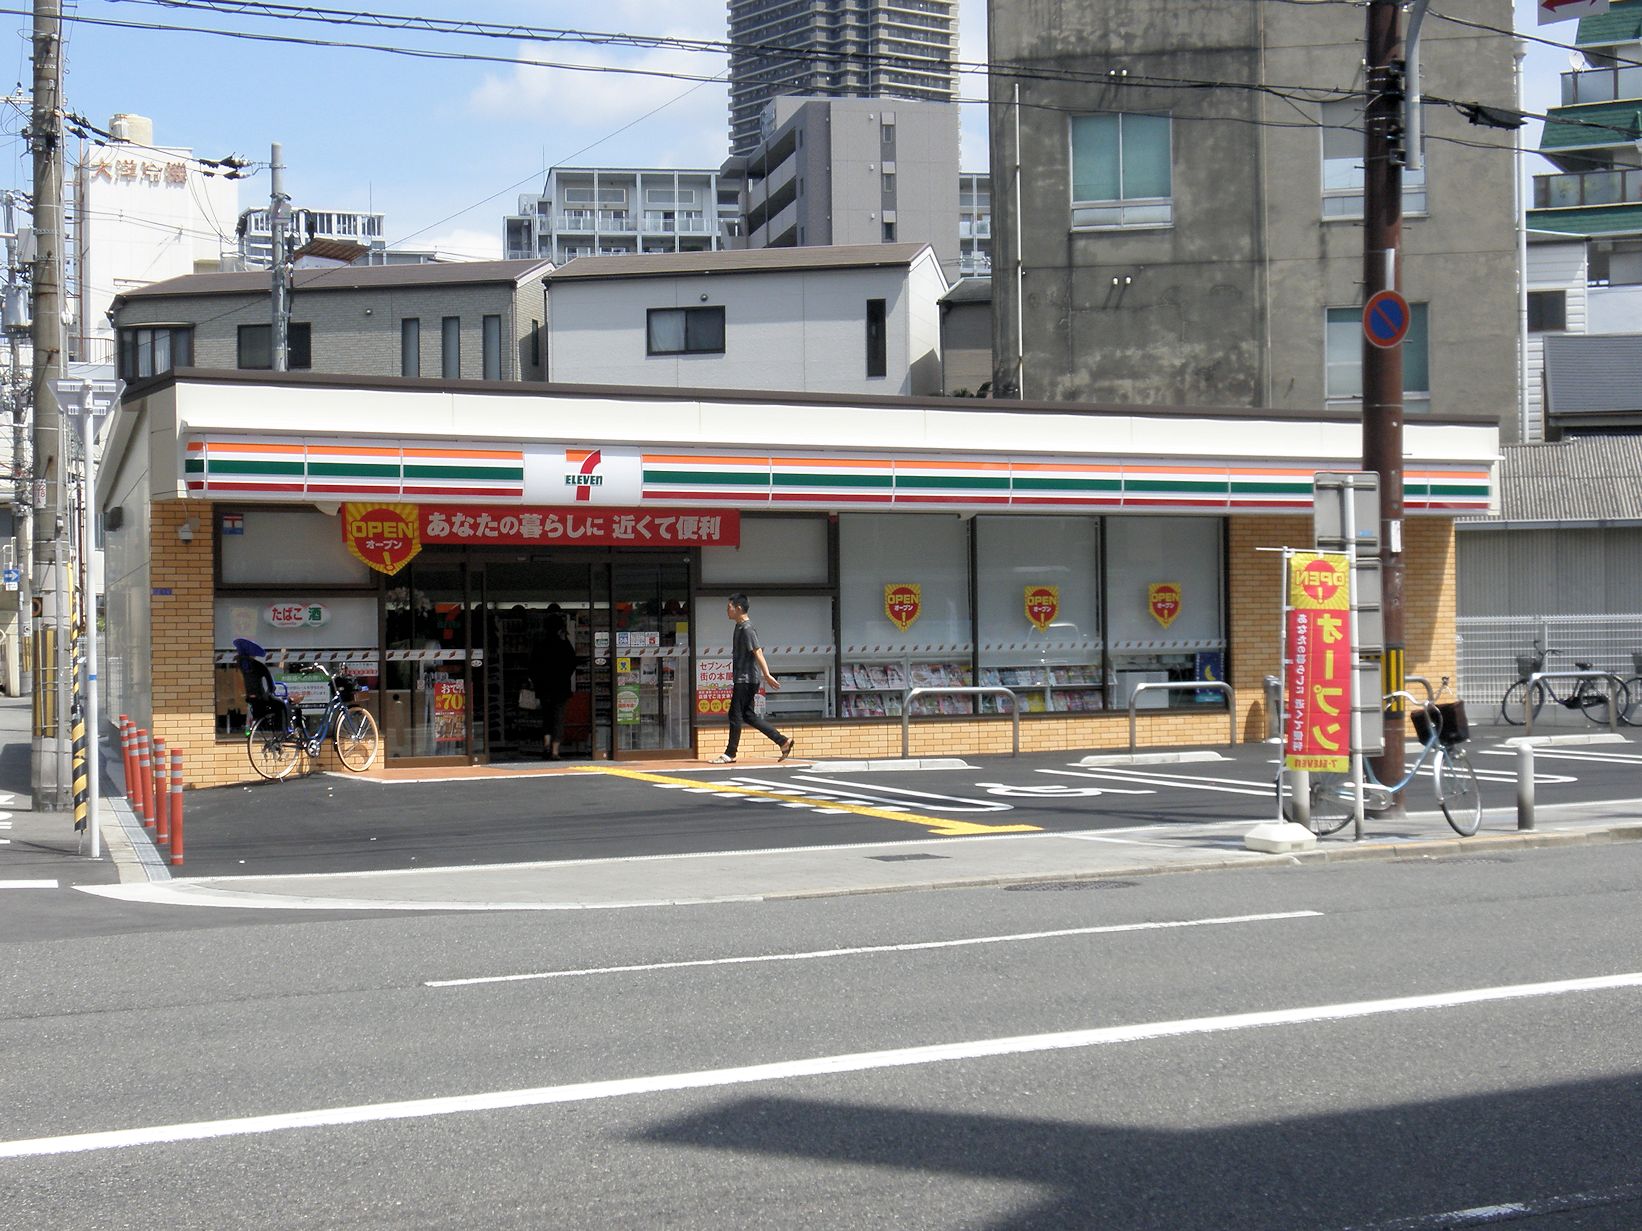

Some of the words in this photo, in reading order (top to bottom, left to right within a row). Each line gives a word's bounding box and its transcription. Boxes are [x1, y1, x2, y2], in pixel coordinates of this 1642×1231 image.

[565, 449, 601, 501] 7
[351, 521, 414, 539] OPEN
[427, 512, 604, 539] あなたの暮らしに
[613, 514, 721, 540] 近くて便利
[366, 540, 402, 550] オープン
[888, 594, 918, 605] OPEN
[1027, 596, 1056, 606] OPEN
[1152, 592, 1179, 602] OPEN
[272, 607, 302, 621] たばこ
[308, 607, 322, 621] 酒
[442, 694, 463, 710] 70
